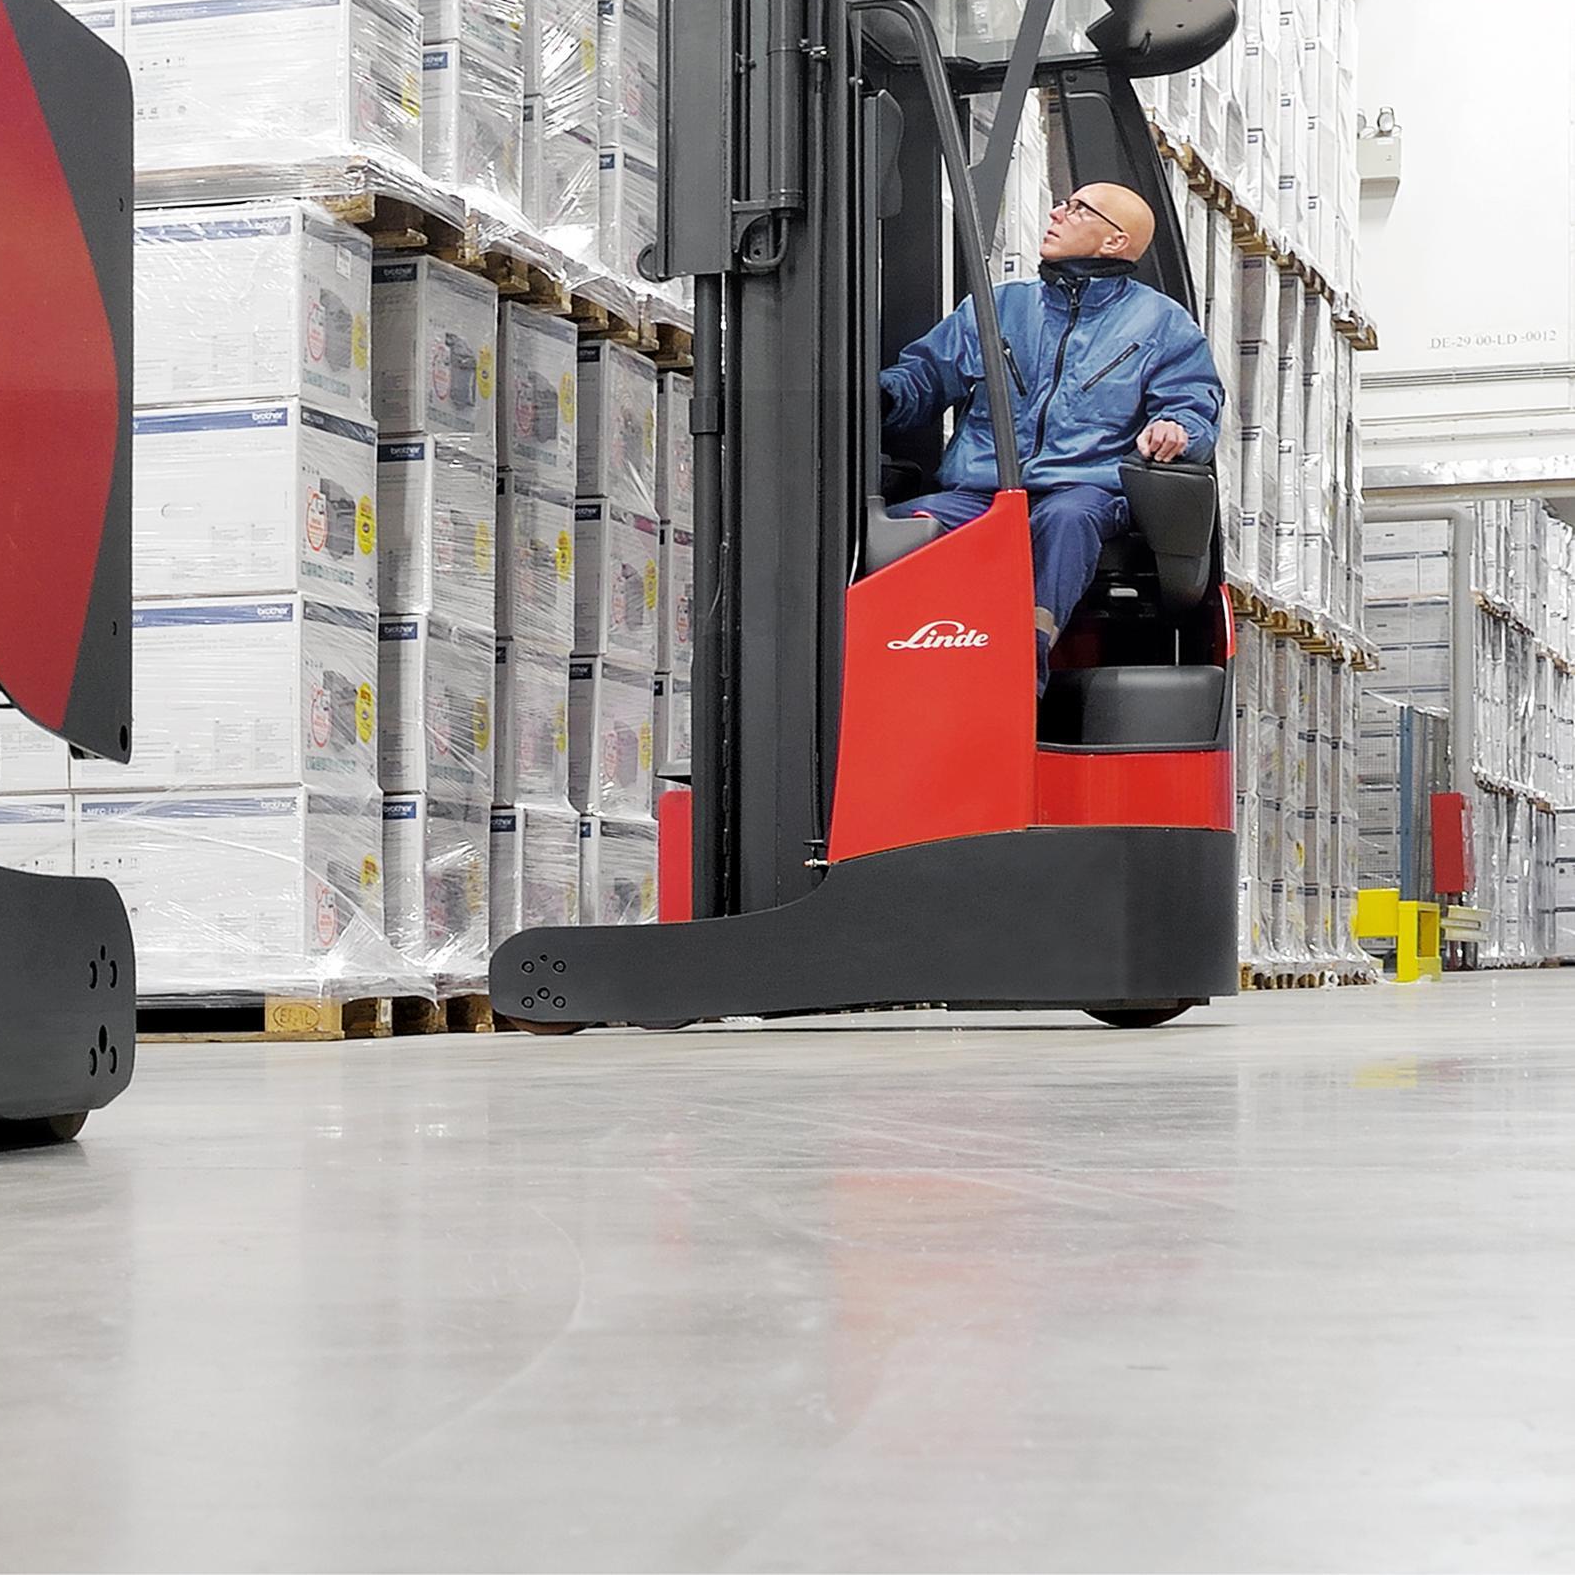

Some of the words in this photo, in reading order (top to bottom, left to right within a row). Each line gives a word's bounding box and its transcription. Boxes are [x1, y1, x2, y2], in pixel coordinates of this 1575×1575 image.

[251, 411, 284, 425] brother
[257, 604, 289, 619] brother
[887, 620, 989, 651] Linde
